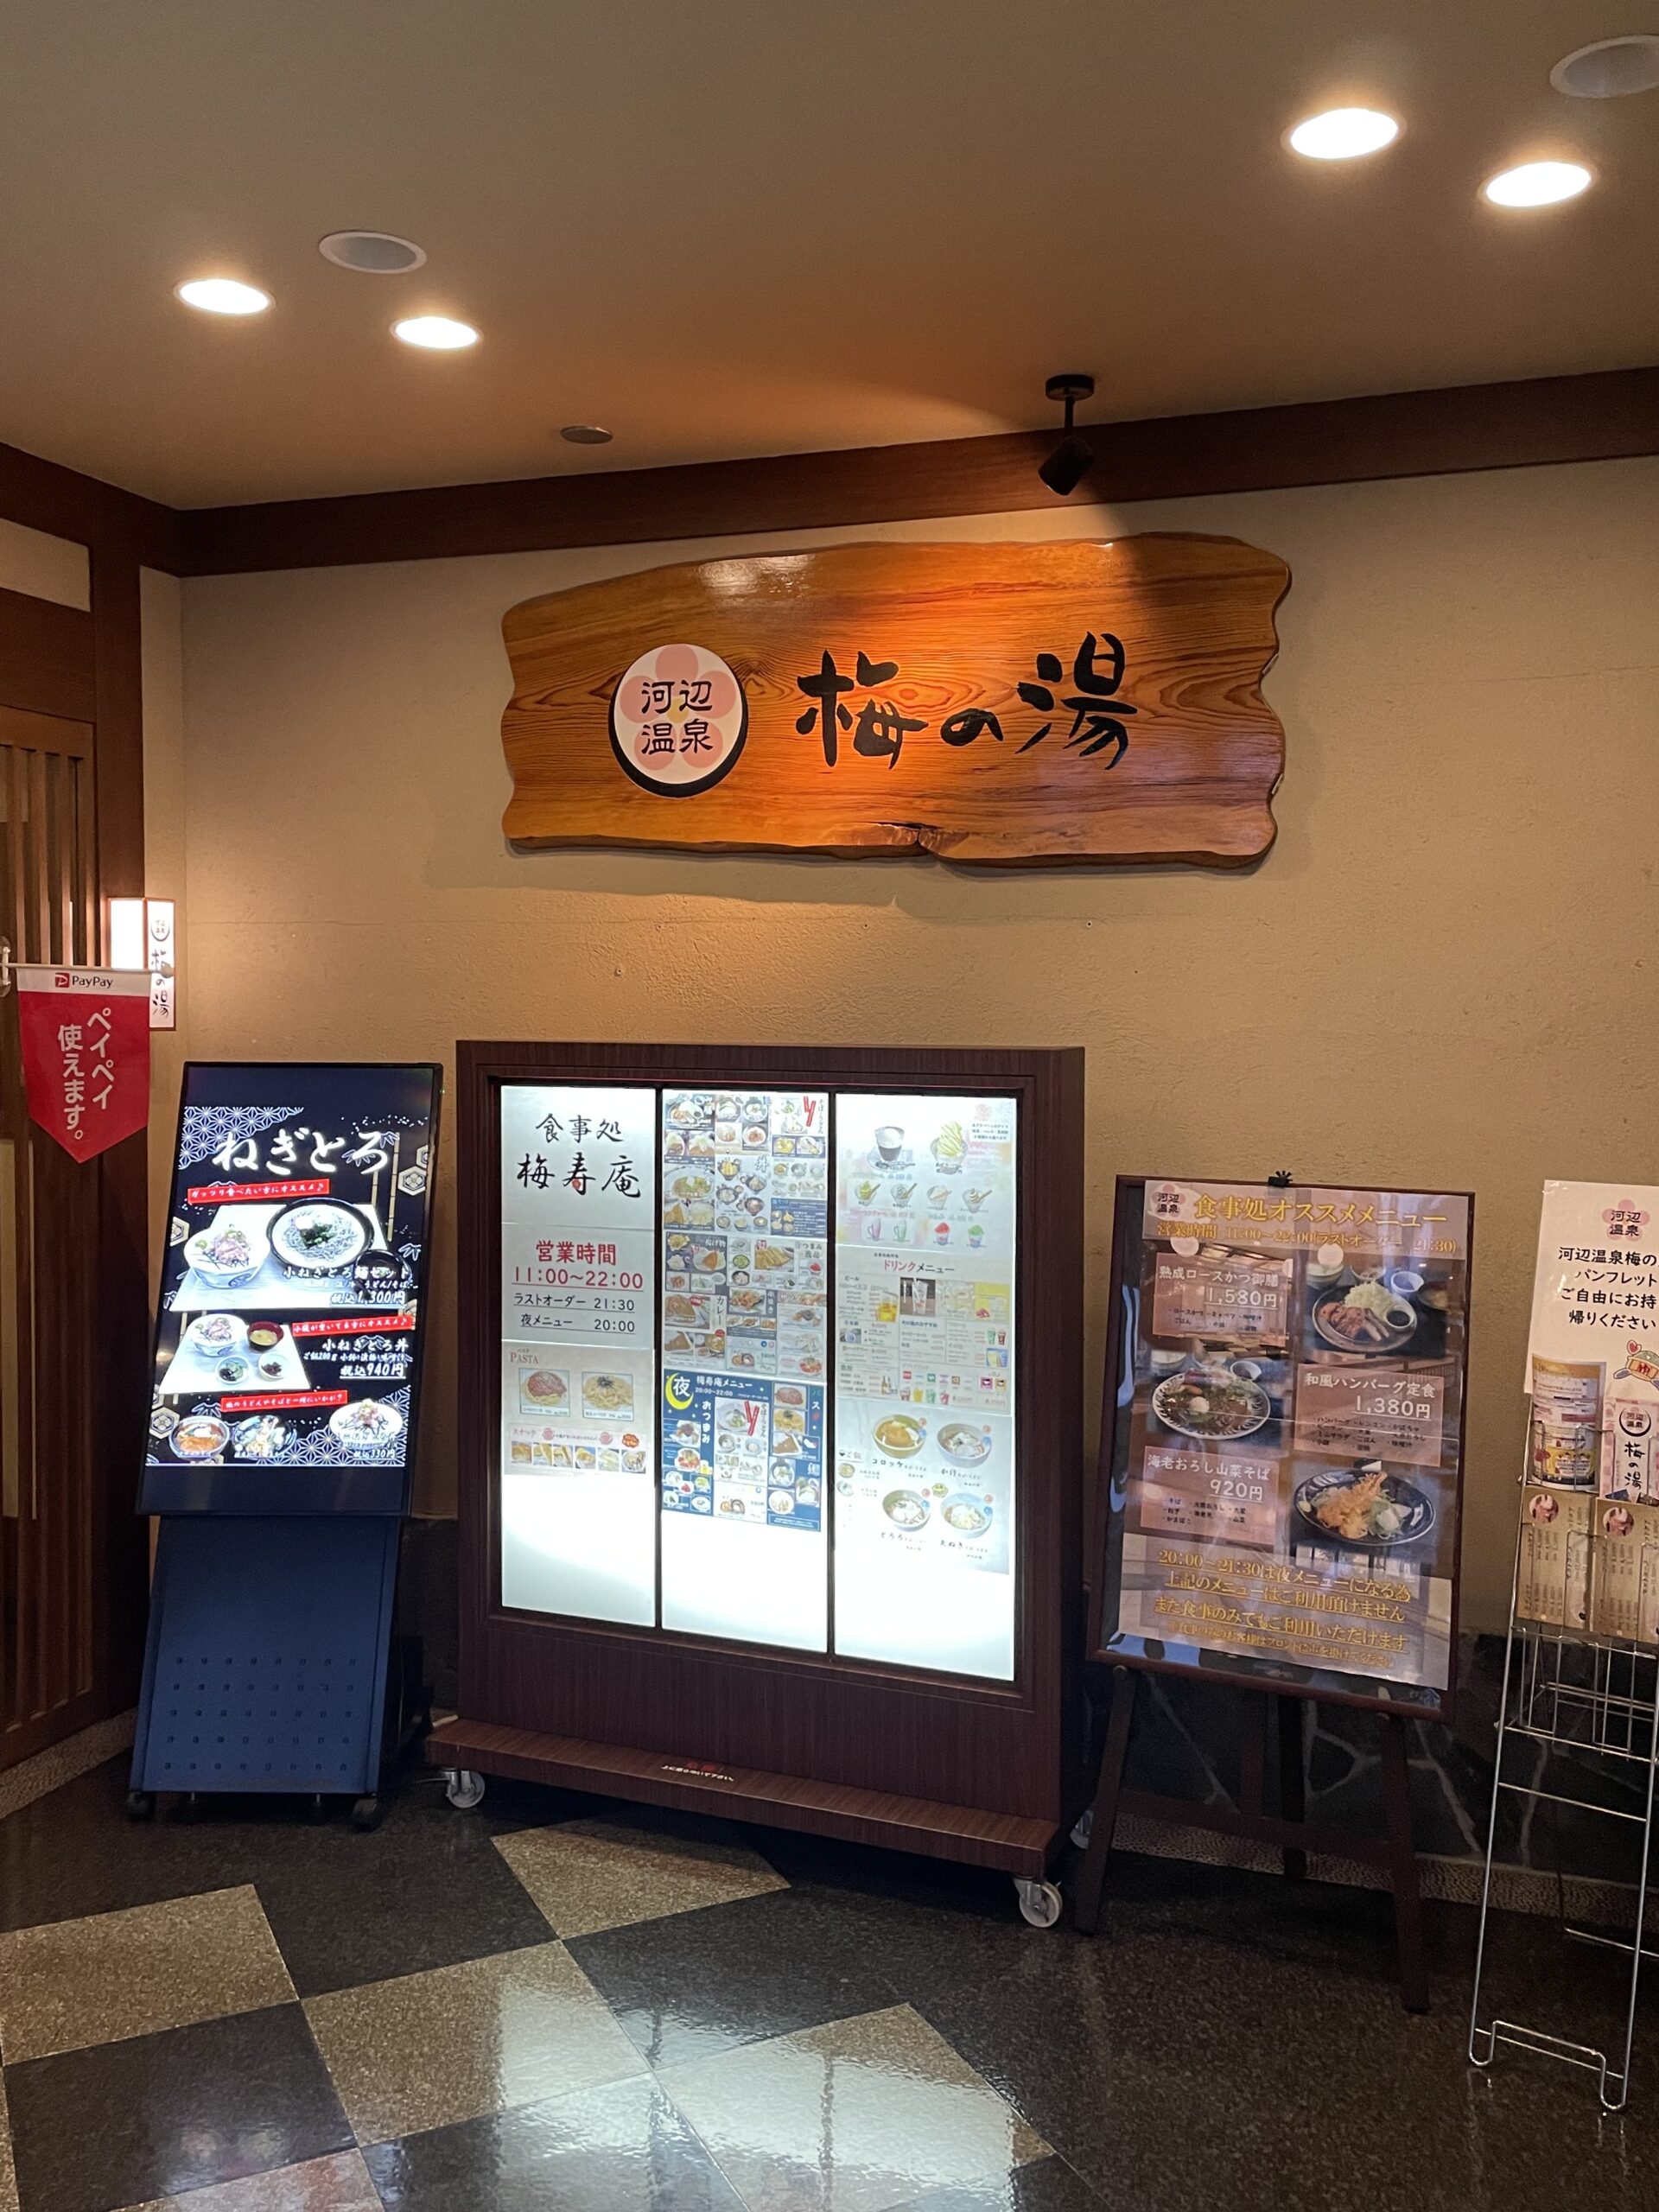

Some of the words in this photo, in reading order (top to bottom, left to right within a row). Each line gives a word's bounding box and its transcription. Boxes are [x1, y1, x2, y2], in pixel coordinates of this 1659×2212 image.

[641, 680, 714, 714] 河辺
[795, 632, 1138, 770] 梅の湯
[640, 719, 715, 754] 温泉
[72, 976, 113, 988] PayPay
[87, 1007, 115, 1109] ペイペイ
[57, 1024, 85, 1140] 使えます。
[536, 1113, 624, 1143] 食事処
[213, 1127, 389, 1175] ねぎとろ
[517, 1153, 641, 1198] 梅寿庵
[1157, 1193, 1179, 1203] 河辺
[1193, 1193, 1448, 1229] 食事処オススメメニュー
[1611, 1211, 1641, 1223] 河辺
[1157, 1221, 1217, 1239] 営業時間
[1609, 1224, 1640, 1236] 温泉
[536, 1240, 617, 1266] 営業時間
[1558, 1247, 1659, 1266] 河辺温泉梅の
[884, 1259, 955, 1274] ドリンクメニュー
[1158, 1265, 1279, 1287] 熟成ロースかつ御膳
[515, 1267, 643, 1289] 11:00〜22:00
[1574, 1269, 1657, 1287] パンフレット
[514, 1293, 586, 1307] ラストオーダー
[594, 1298, 635, 1312] 21:30
[1207, 1287, 1278, 1308] 1,580円
[1561, 1288, 1659, 1309] ご自由にお持
[520, 1314, 573, 1328] 夜メニュー
[594, 1319, 635, 1332] 20:00
[1569, 1310, 1656, 1330] 帰りください
[673, 1376, 690, 1397] 夜
[1304, 1371, 1437, 1398] 和風ハンバーグ定食
[1356, 1395, 1431, 1420] 1,380円
[1147, 1453, 1271, 1481] 海老おろし山菜そば
[1211, 1480, 1264, 1502] 920円
